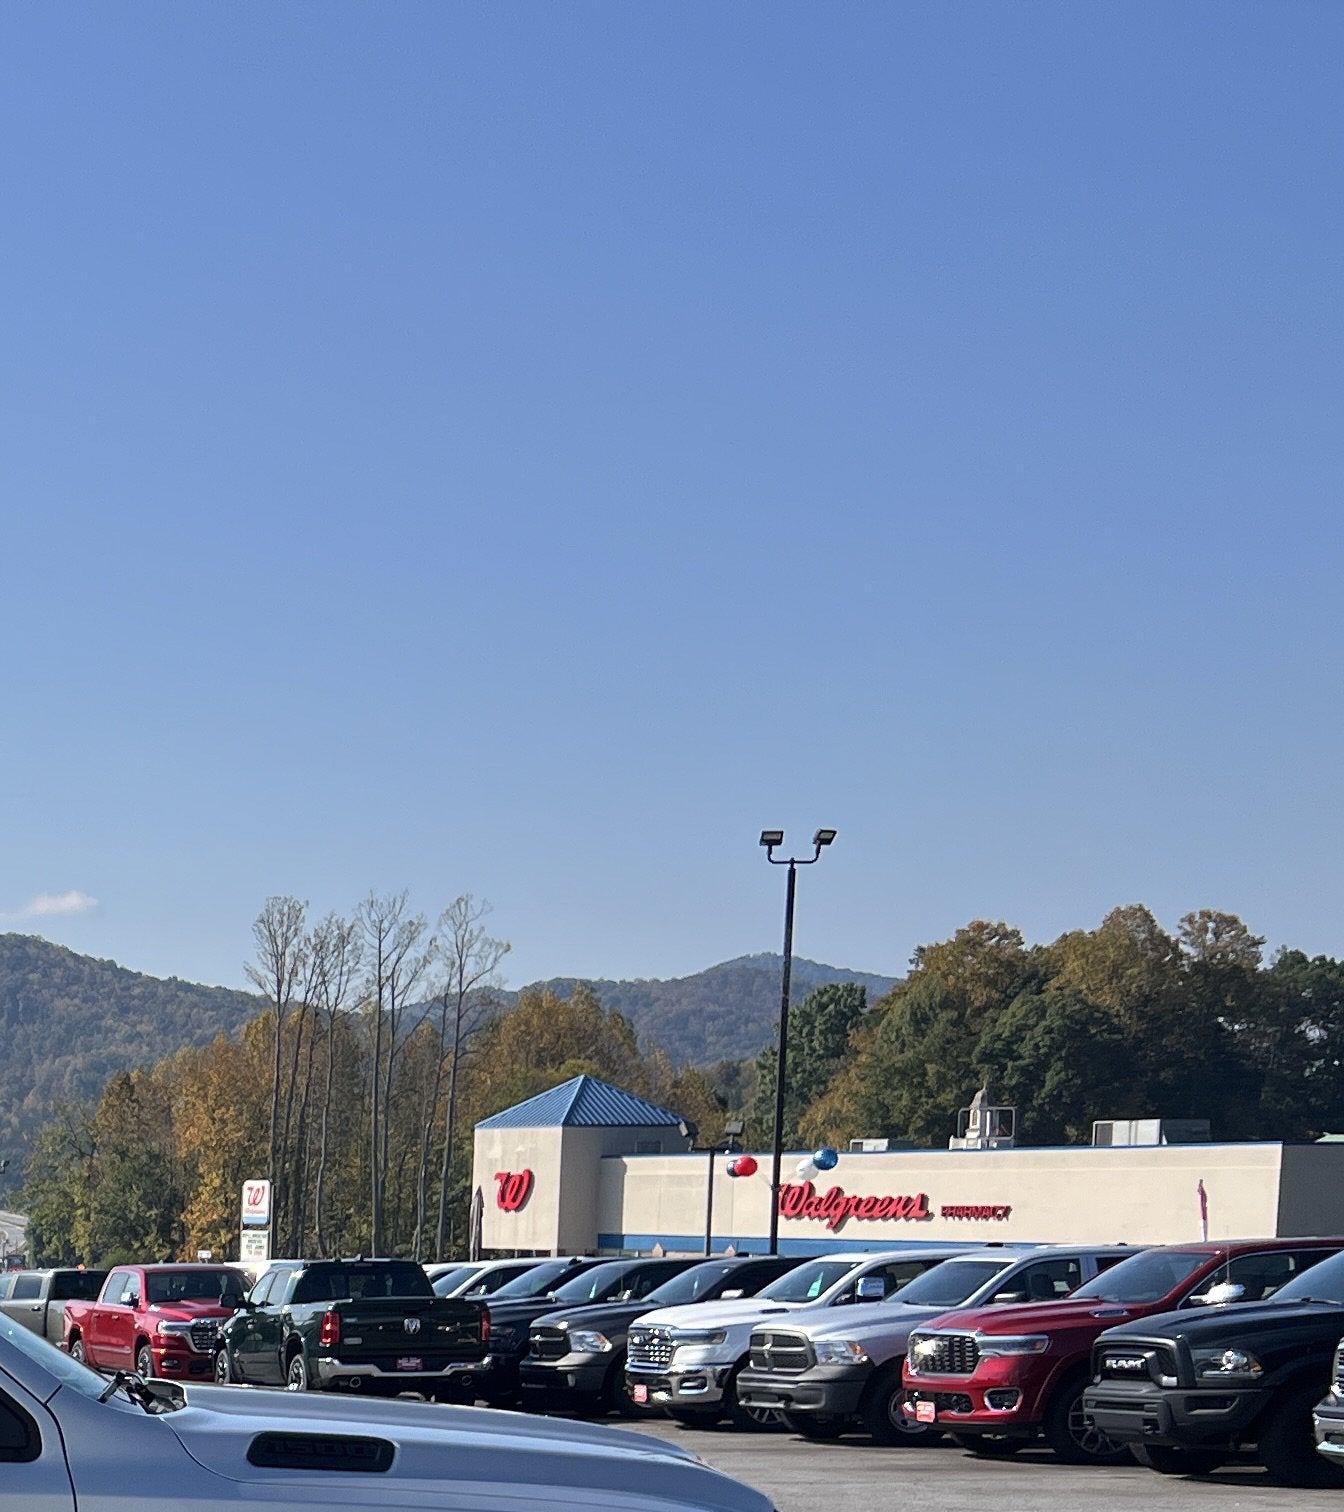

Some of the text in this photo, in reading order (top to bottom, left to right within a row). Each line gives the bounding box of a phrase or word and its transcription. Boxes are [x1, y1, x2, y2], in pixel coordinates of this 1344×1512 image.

[247, 1185, 266, 1206] W
[494, 1169, 532, 1211] W
[778, 1180, 932, 1232] Walgreens
